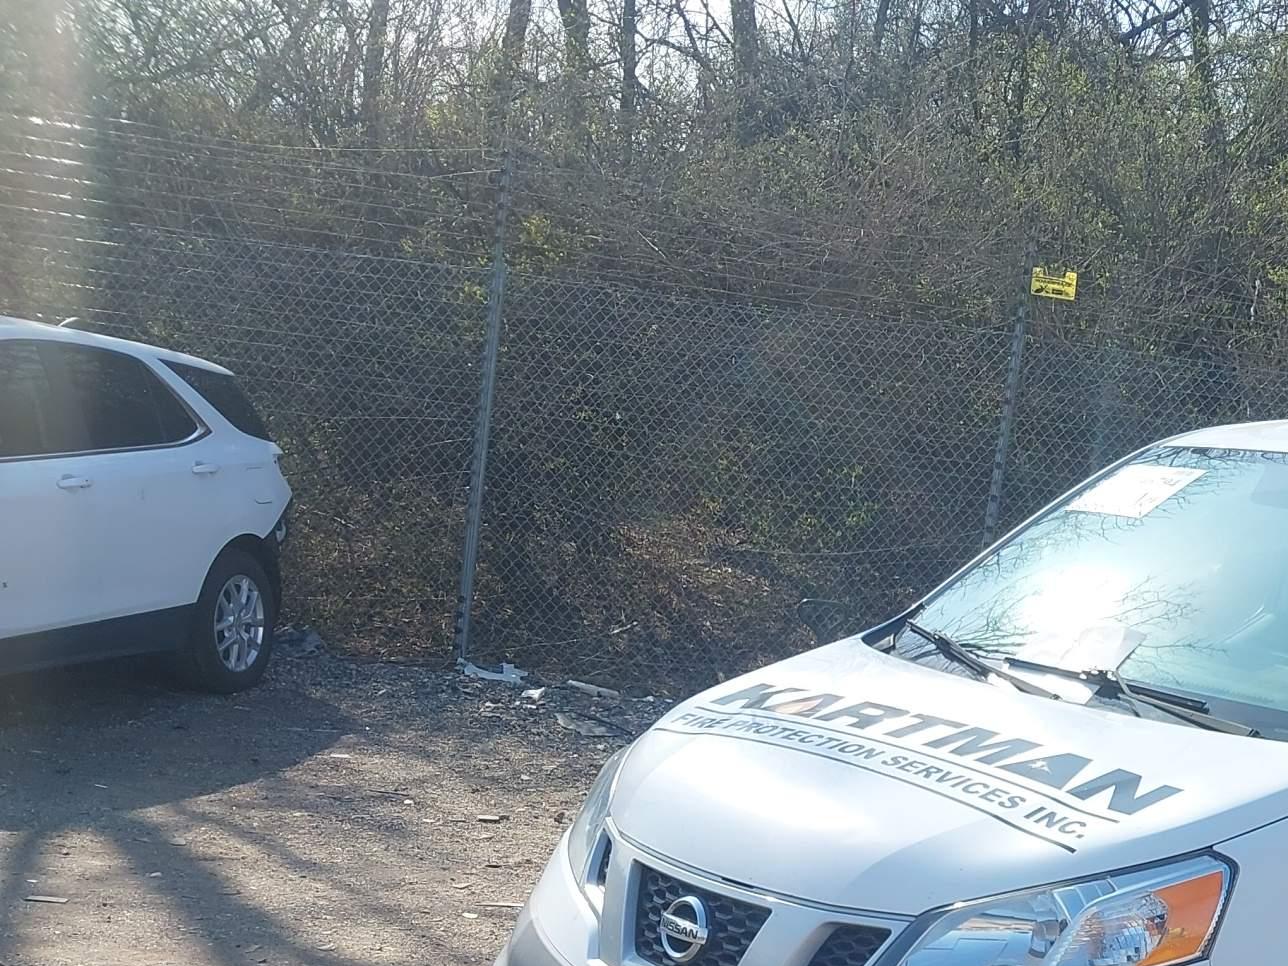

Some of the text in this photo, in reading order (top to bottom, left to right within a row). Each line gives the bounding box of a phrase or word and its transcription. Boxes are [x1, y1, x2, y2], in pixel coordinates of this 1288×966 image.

[671, 713, 1088, 839] FIRE PROTECTION SERVICES INC.
[710, 683, 1184, 815] KARTMAN
[661, 915, 699, 940] NISSAN
